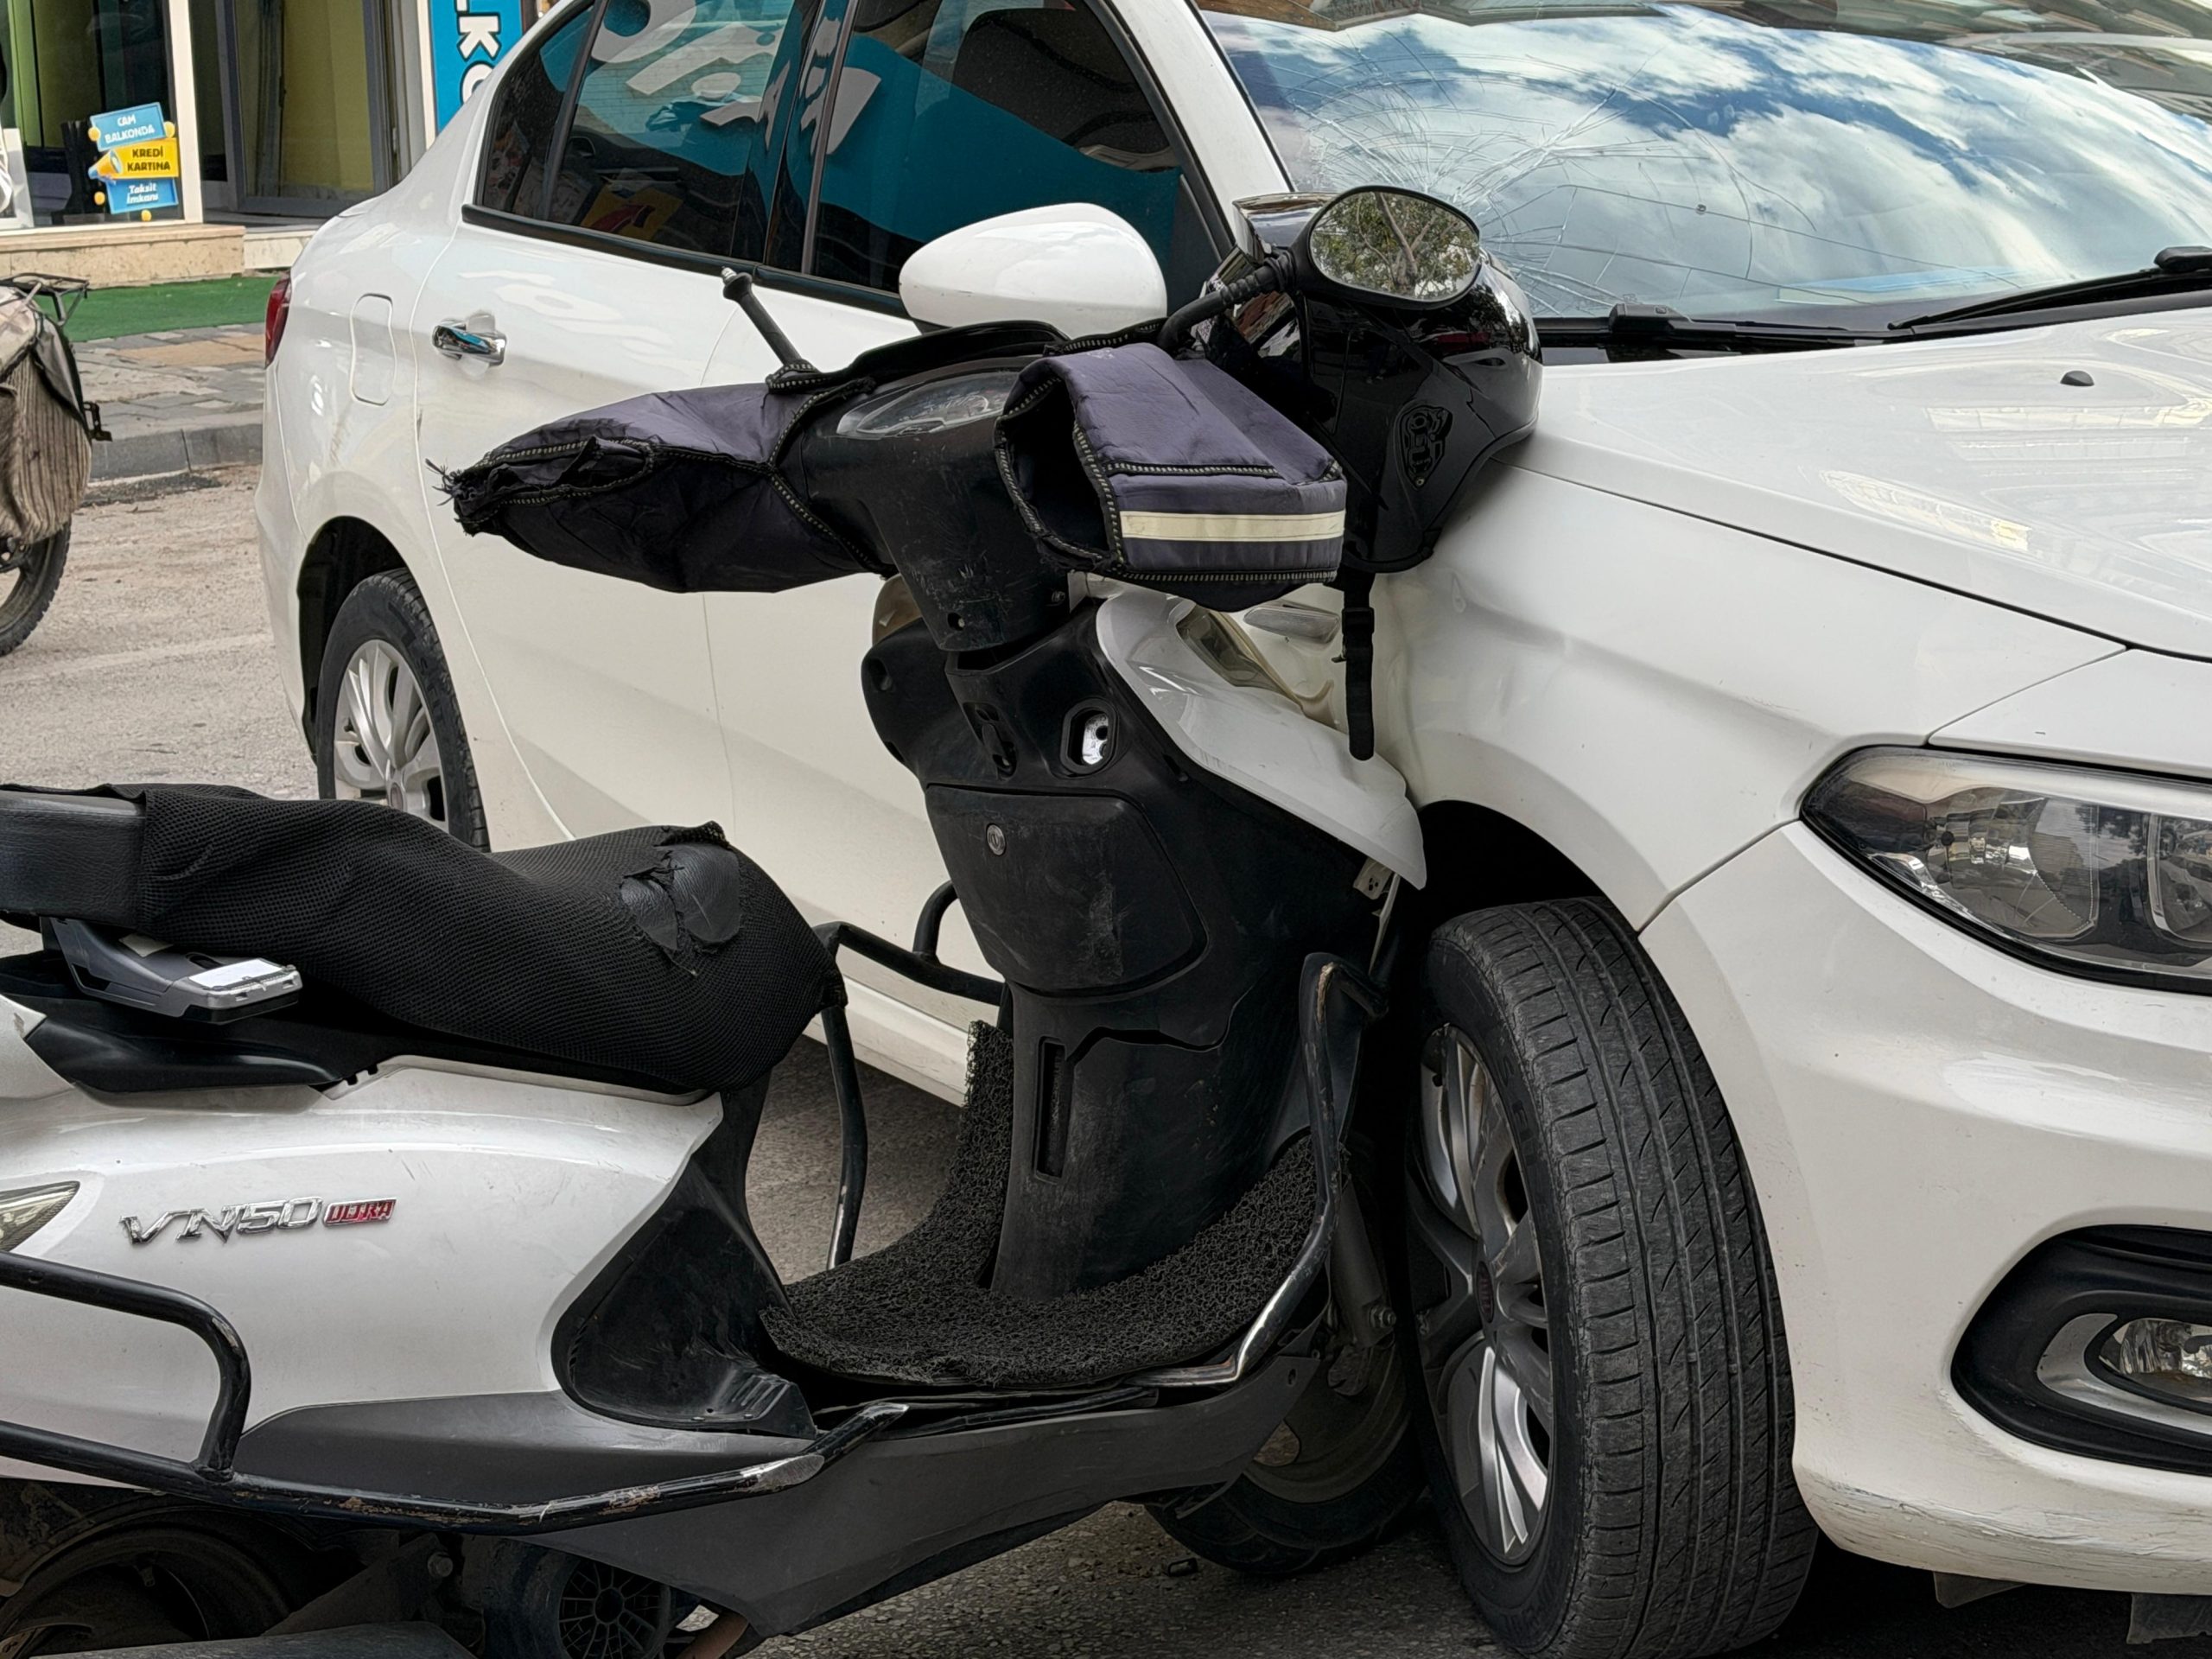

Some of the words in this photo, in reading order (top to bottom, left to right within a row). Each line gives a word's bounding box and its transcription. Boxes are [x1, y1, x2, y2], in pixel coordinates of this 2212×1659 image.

[118, 114, 136, 126] CAM
[105, 124, 155, 143] BALKONDA
[132, 146, 162, 157] KREDİ
[127, 162, 170, 171] KARTINA
[129, 183, 156, 194] Taksit
